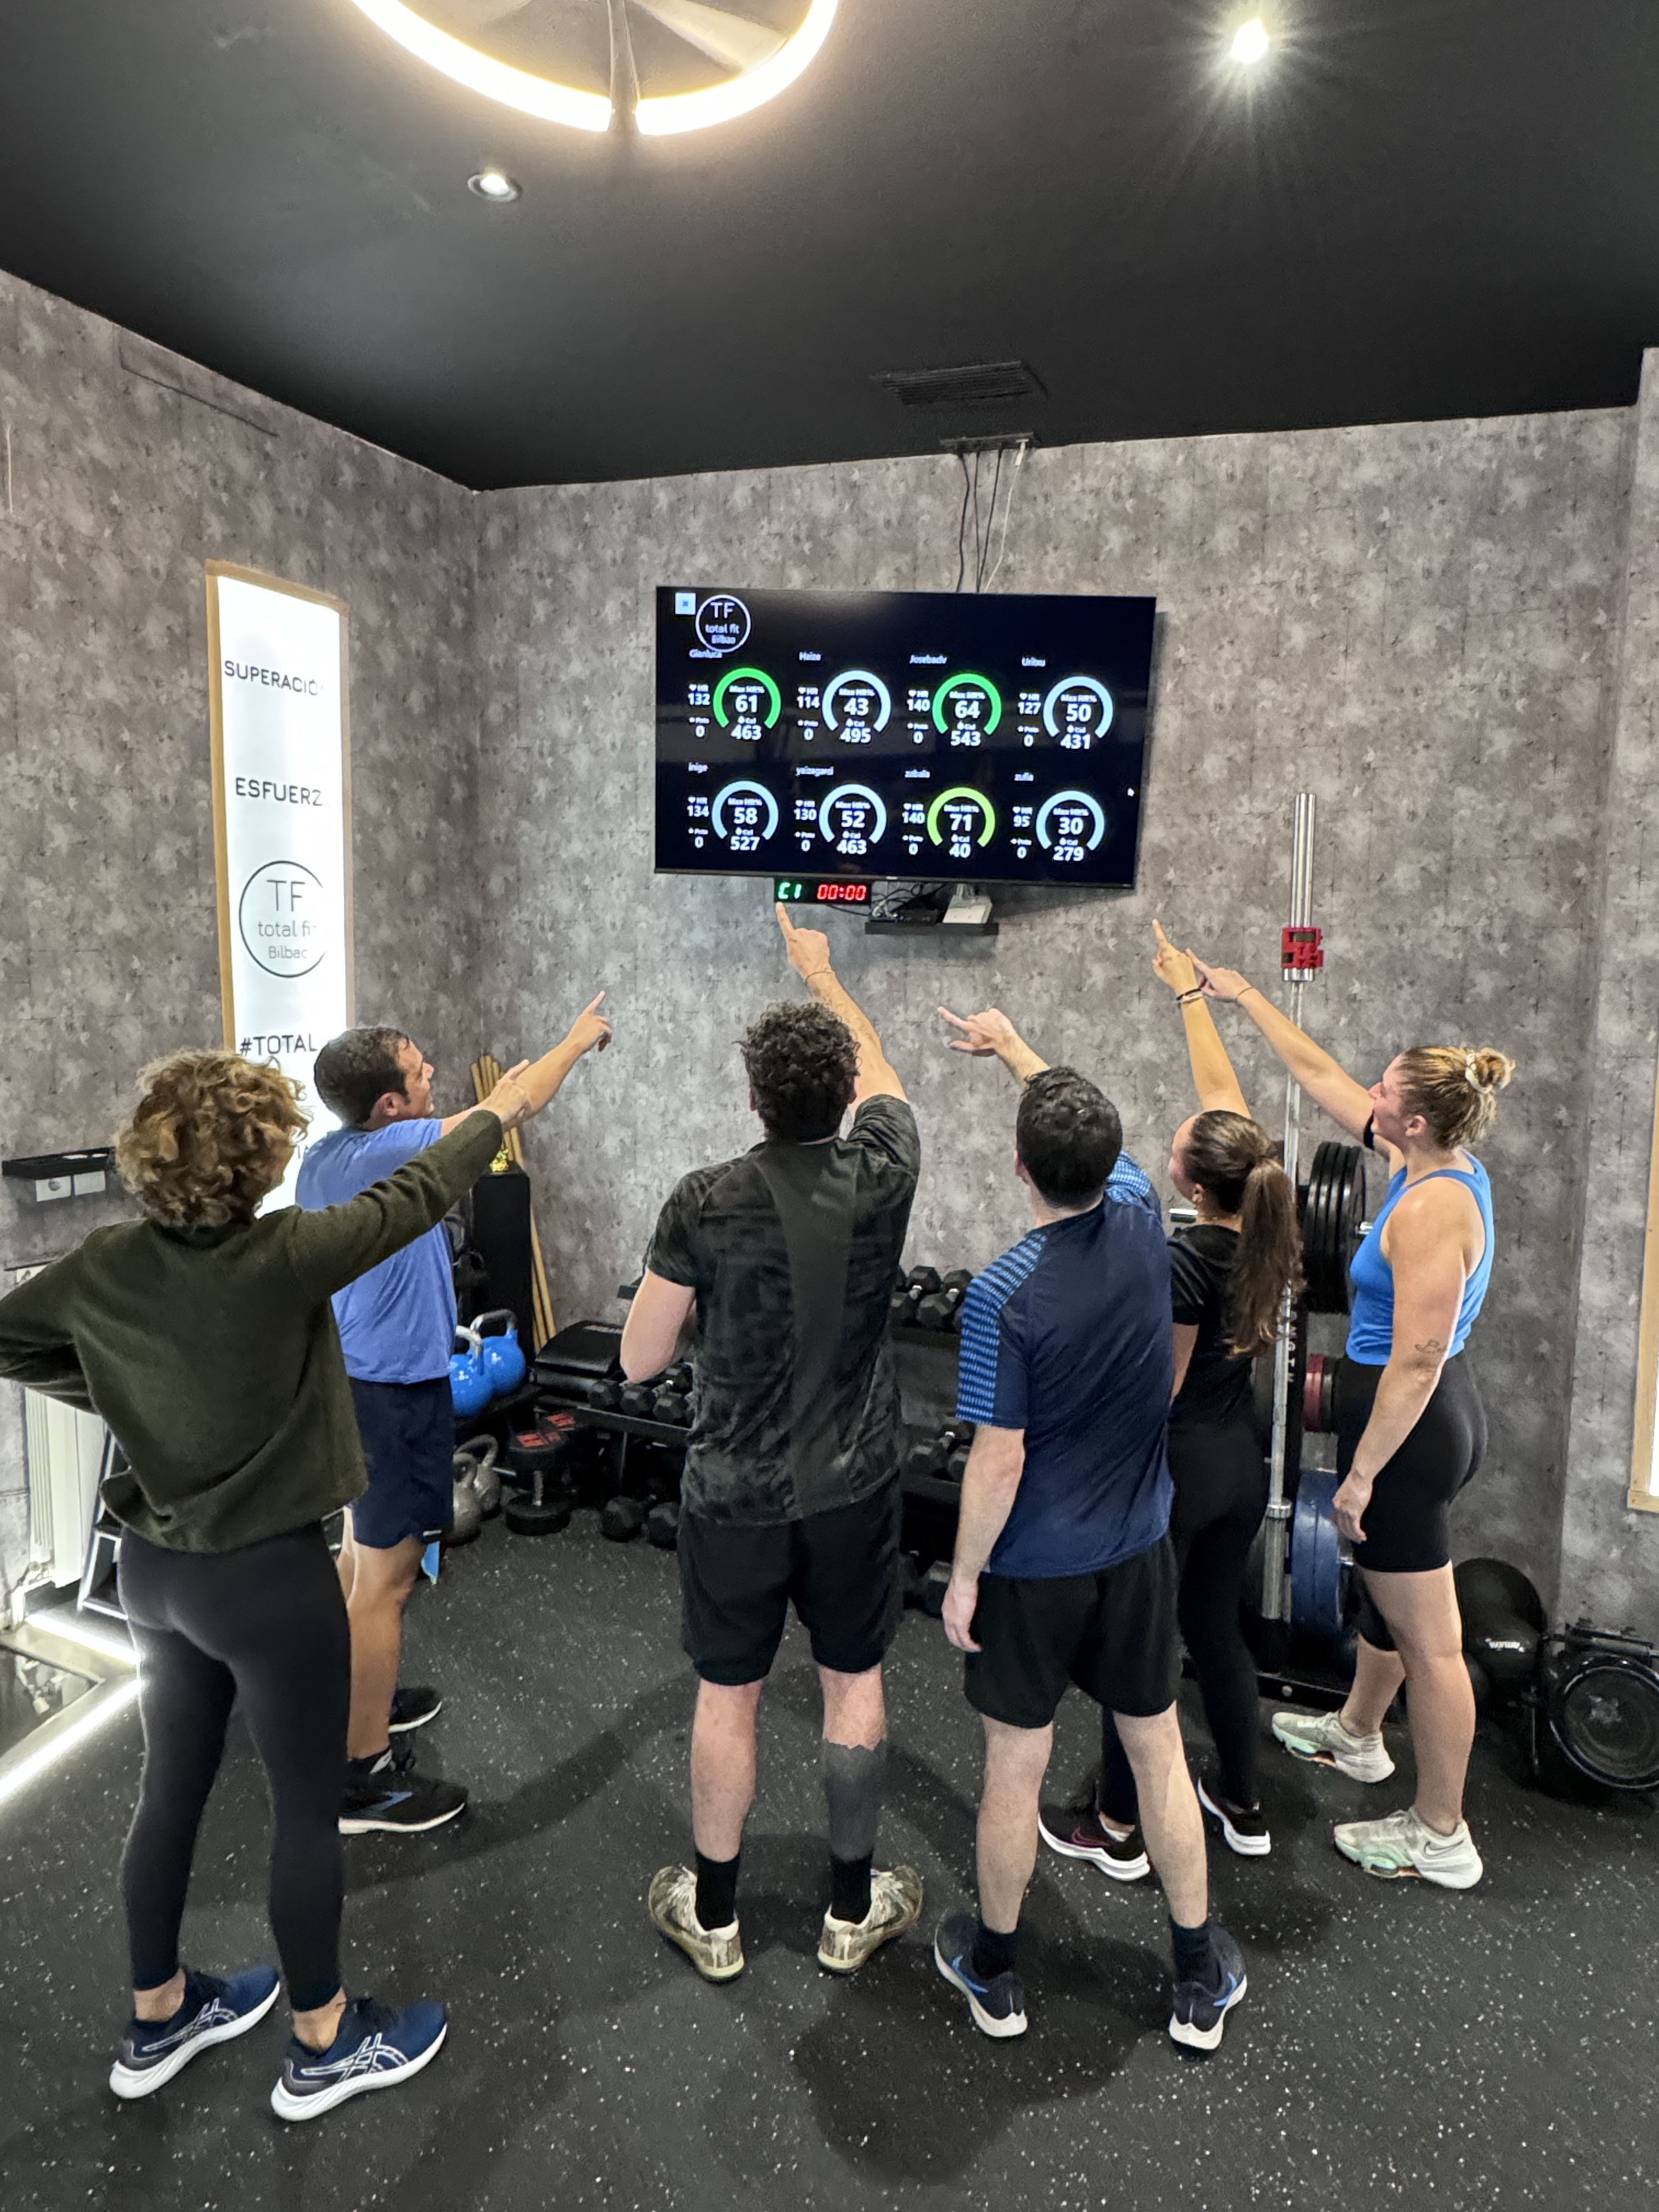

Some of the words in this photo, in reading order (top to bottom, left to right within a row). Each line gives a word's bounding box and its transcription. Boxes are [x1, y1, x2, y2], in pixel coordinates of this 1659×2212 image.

[710, 602, 735, 618] TF
[224, 660, 324, 696] SUPERACIÓ
[688, 692, 710, 706] 132
[735, 695, 758, 713] 61
[797, 696, 820, 709] 114
[844, 697, 869, 716] 43
[906, 698, 930, 712] 140
[955, 700, 980, 719] 64
[1017, 701, 1041, 715] 127
[1065, 703, 1092, 722] 50
[695, 725, 706, 737] 0
[731, 724, 761, 741] 463
[804, 728, 814, 741] 0
[839, 727, 871, 743] 495
[913, 731, 924, 744] 0
[950, 729, 981, 746] 543
[1024, 734, 1034, 747] 0
[1060, 733, 1091, 749] 431
[235, 777, 330, 806] ESFUERZ
[687, 805, 709, 817] 134
[733, 807, 758, 825] 58
[793, 808, 817, 821] 130
[841, 810, 865, 828] 52
[902, 811, 925, 824] 140
[949, 813, 972, 832] 71
[1013, 815, 1030, 827] 95
[1058, 816, 1084, 835] 30
[695, 836, 704, 848] 0
[730, 836, 760, 851] 527
[801, 839, 811, 851] 0
[836, 838, 867, 855] 463
[909, 843, 918, 855] 0
[949, 843, 971, 858] 40
[1017, 846, 1027, 859] 0
[1052, 845, 1084, 861] 279
[266, 879, 306, 912] TF
[257, 920, 297, 937] total
[301, 920, 317, 937] fi
